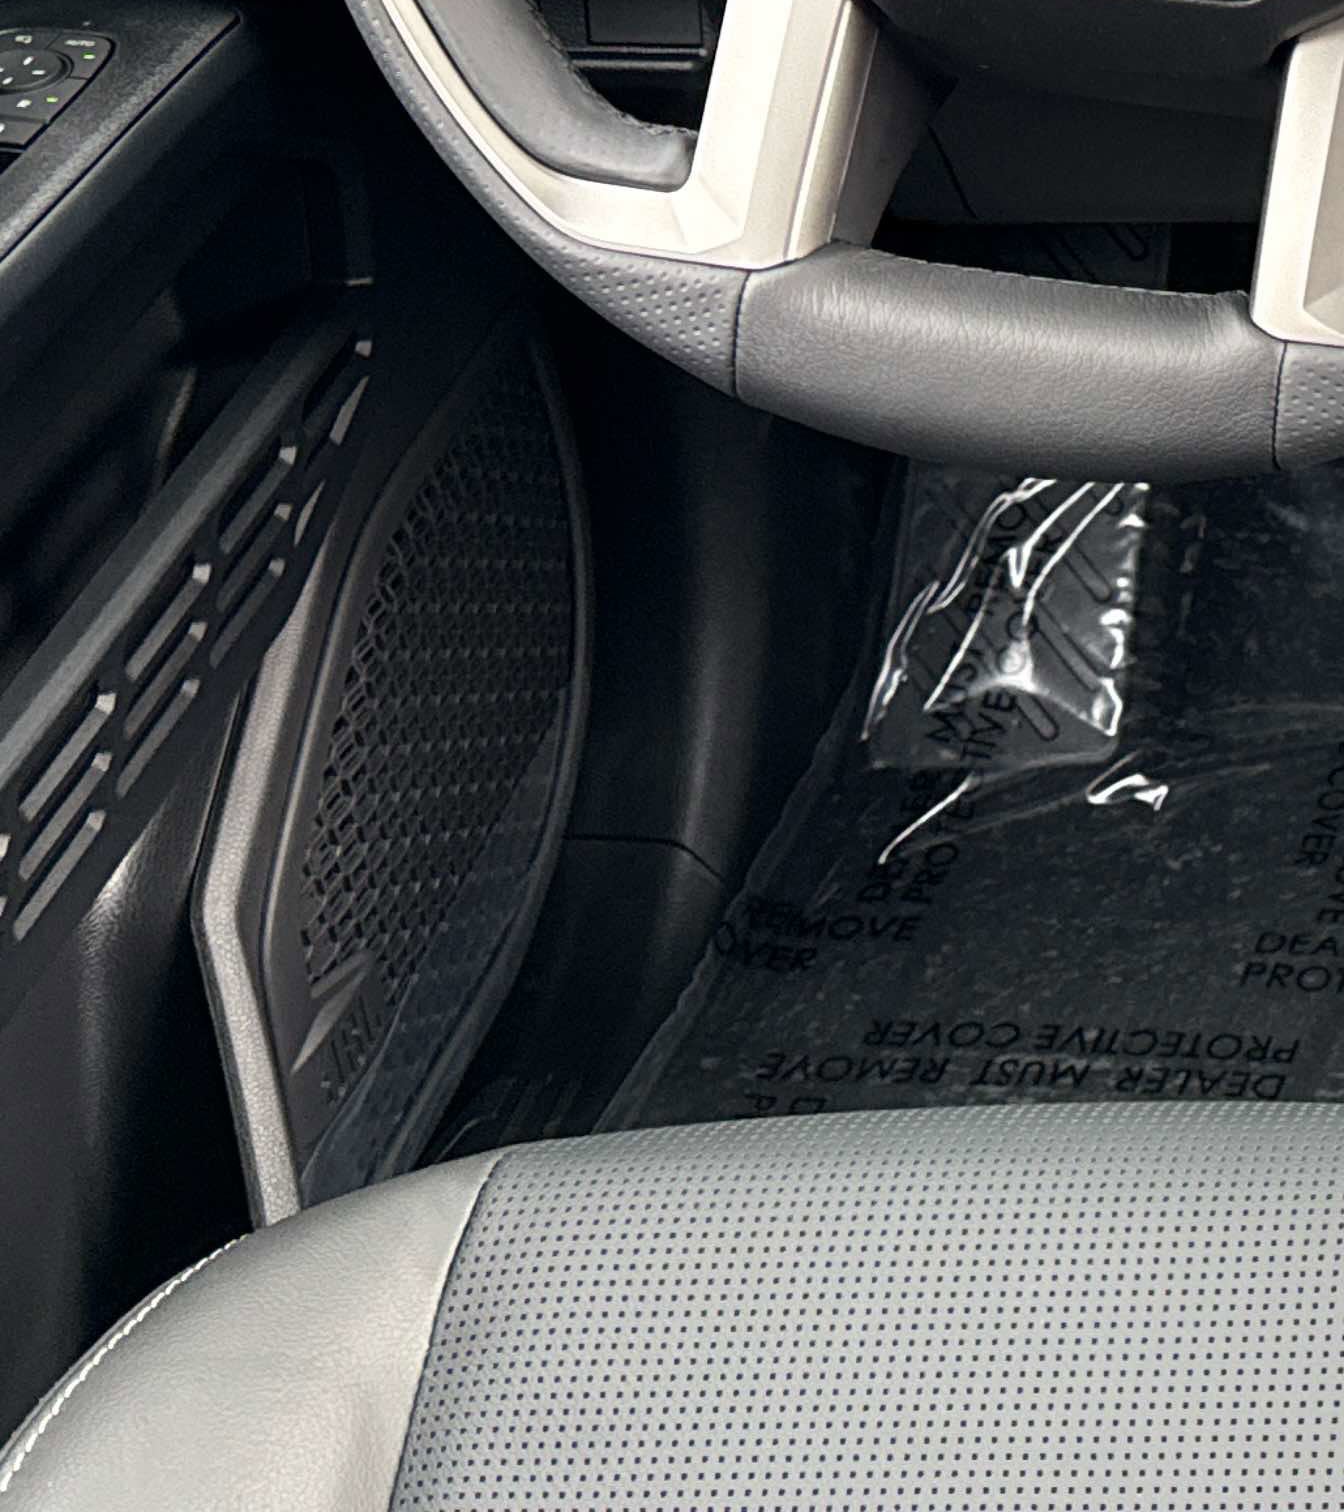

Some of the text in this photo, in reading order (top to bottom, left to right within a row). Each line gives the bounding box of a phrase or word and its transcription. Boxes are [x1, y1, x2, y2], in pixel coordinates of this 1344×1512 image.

[864, 1018, 1301, 1065] PROTECTIVE COVER
[756, 1050, 1288, 1101] DEALER MUST REMOVE
